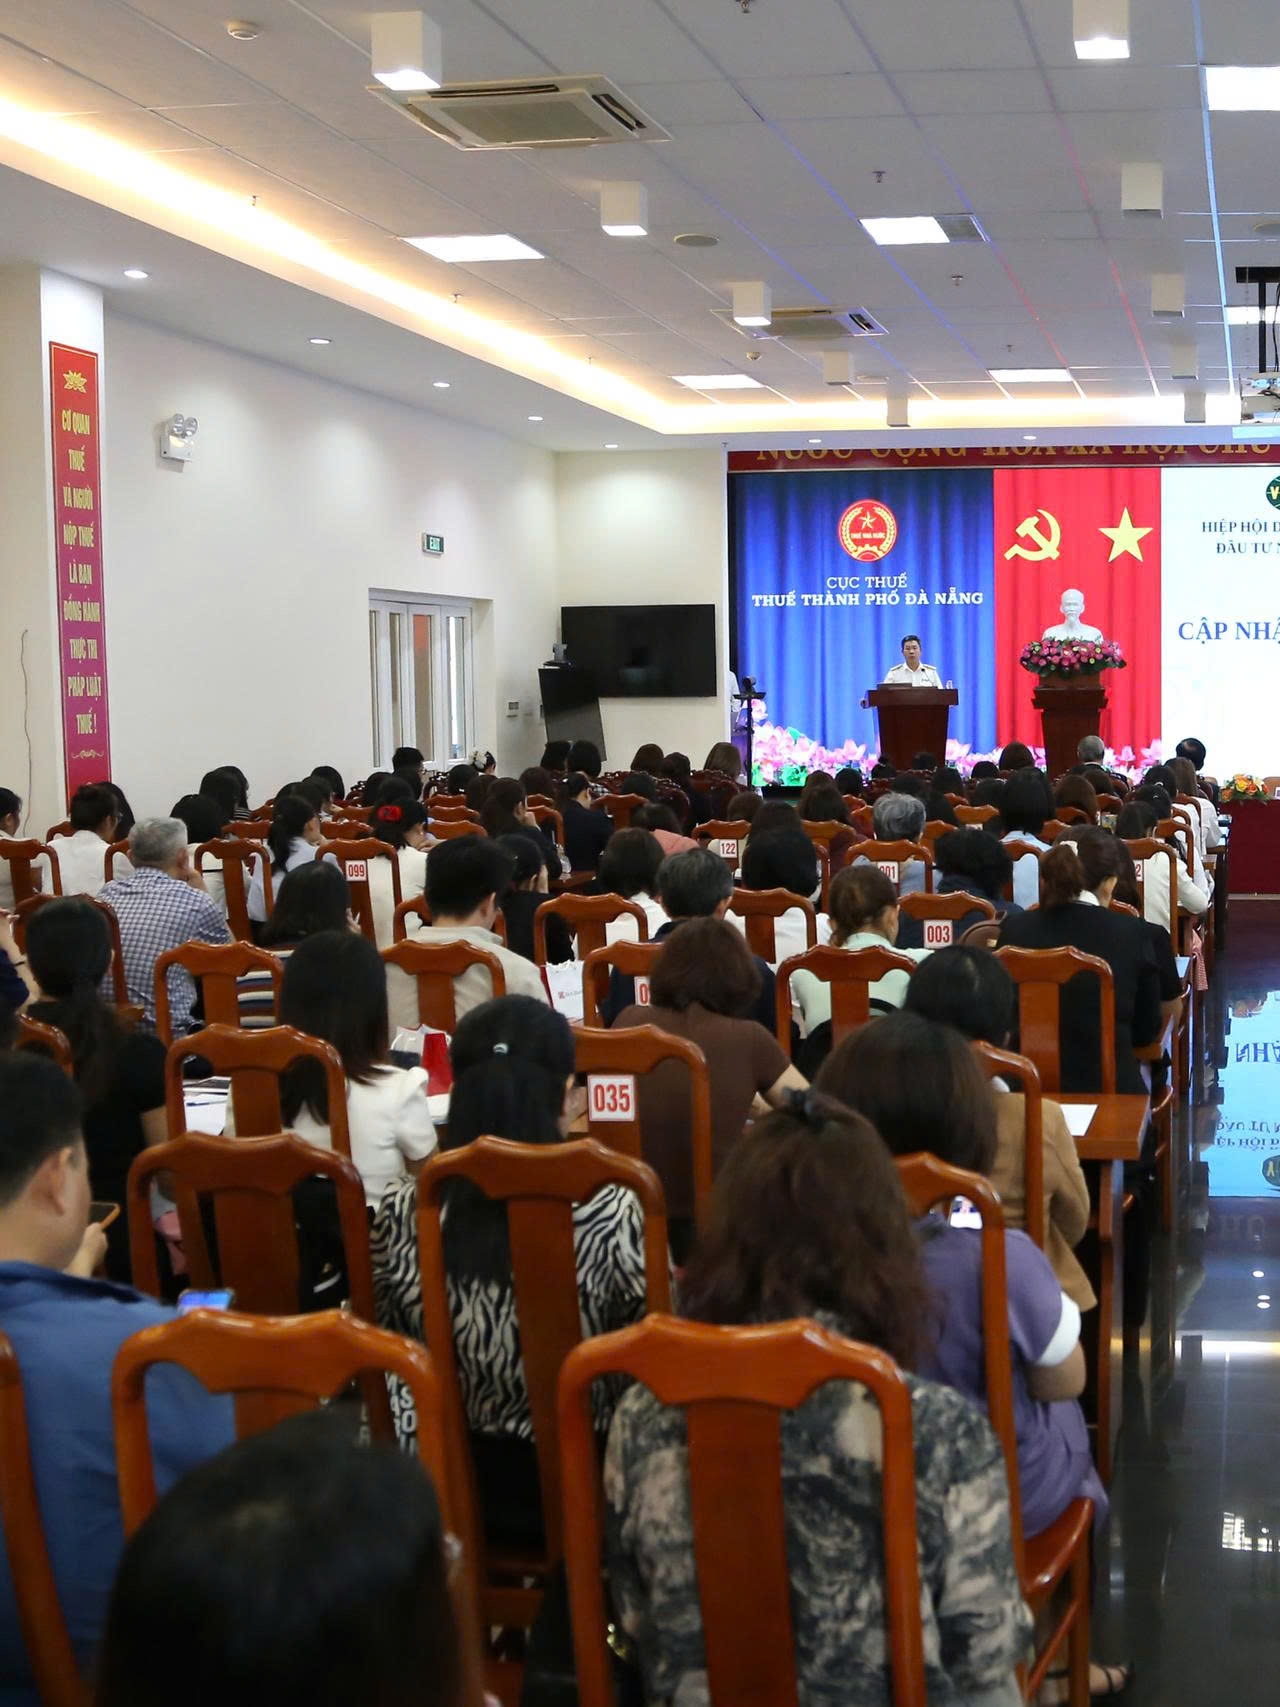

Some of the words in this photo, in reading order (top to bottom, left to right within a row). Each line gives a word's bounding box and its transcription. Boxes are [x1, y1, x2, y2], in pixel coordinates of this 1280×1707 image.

[1202, 518, 1237, 535] HIỆP
[1241, 518, 1268, 535] HỘI
[1251, 542, 1272, 554] TƯ
[826, 576, 860, 590] CỤC
[865, 571, 908, 588] THUẾ
[752, 590, 796, 607] THUẾ
[801, 589, 860, 606] THÀNH
[863, 588, 899, 606] PHỐ
[905, 588, 930, 605] ĐÀ
[935, 587, 984, 605] NẴNG
[1178, 616, 1228, 645] CẬP
[721, 843, 736, 855] 122
[348, 864, 365, 877] 099
[927, 925, 950, 943] 003
[594, 1083, 631, 1113] 035
